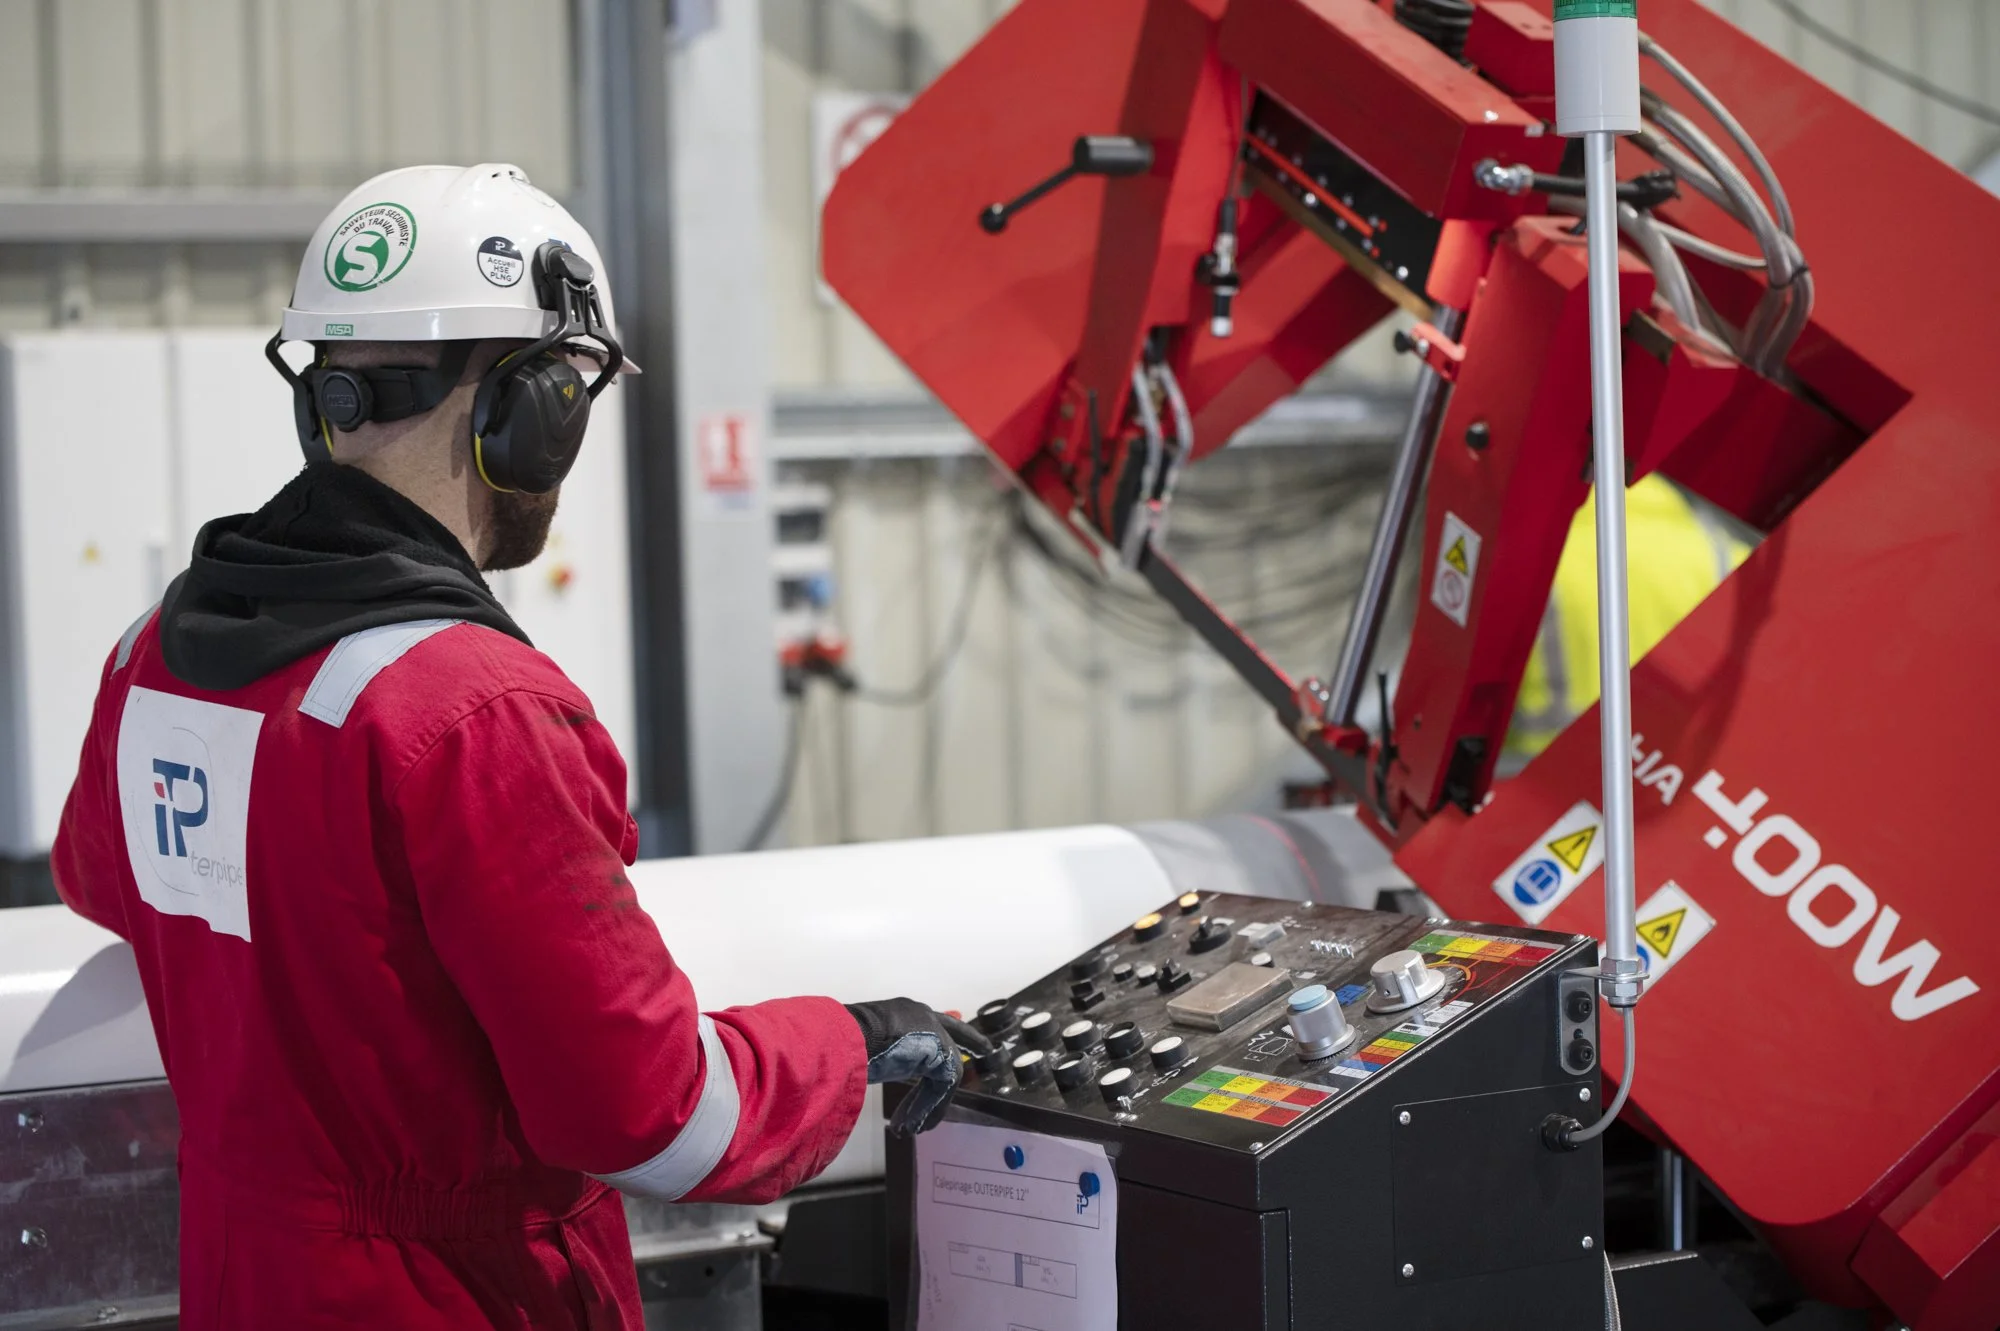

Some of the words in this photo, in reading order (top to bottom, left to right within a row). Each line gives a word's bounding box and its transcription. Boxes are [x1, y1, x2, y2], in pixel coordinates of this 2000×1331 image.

[340, 208, 386, 236] SAUVETEUR
[385, 209, 409, 247] SECOURISTE
[353, 223, 365, 233] DU
[368, 217, 395, 237] TRAVAIL
[487, 256, 516, 268] Accueil
[493, 265, 510, 275] HSE
[490, 271, 512, 282] PLNG
[326, 324, 353, 336] MSA
[974, 1181, 1015, 1200] OUTERPIPE
